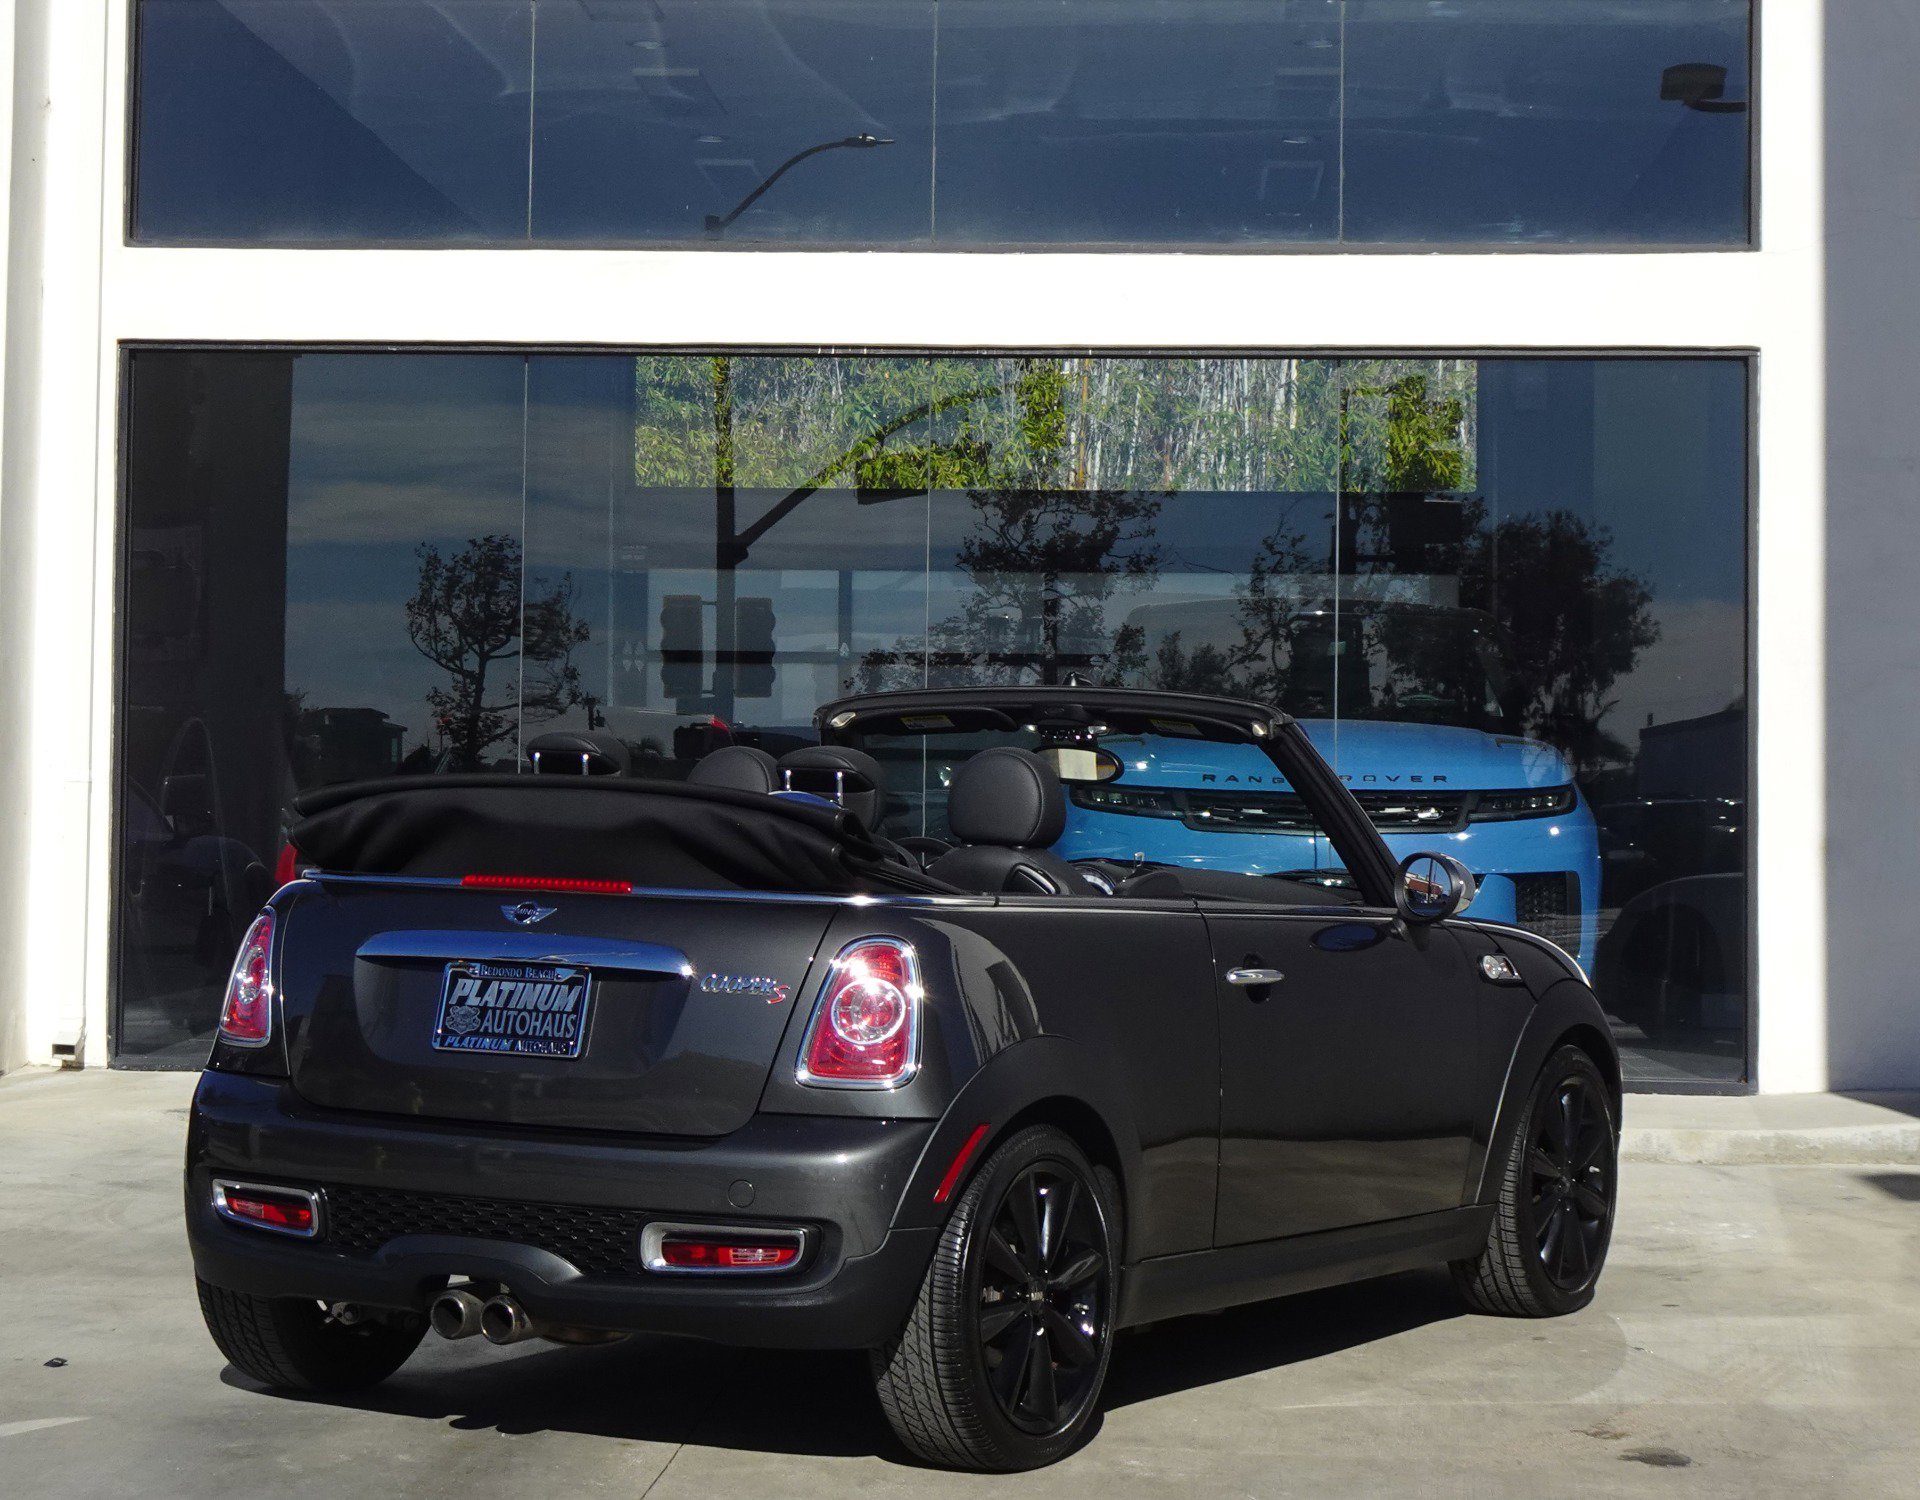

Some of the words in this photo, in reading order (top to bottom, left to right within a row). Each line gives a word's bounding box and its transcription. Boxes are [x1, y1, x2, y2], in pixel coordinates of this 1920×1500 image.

[1202, 773, 1287, 784] RANG
[1338, 774, 1447, 783] ROVER
[480, 964, 522, 978] REDONDO
[525, 966, 555, 979] BEACH
[448, 978, 583, 1012] PLATINUM
[766, 985, 790, 1004] S
[479, 1009, 577, 1038] AUTOHAUS
[444, 1035, 513, 1050] PLATINUM
[514, 1040, 566, 1054] AUTOHAUS
